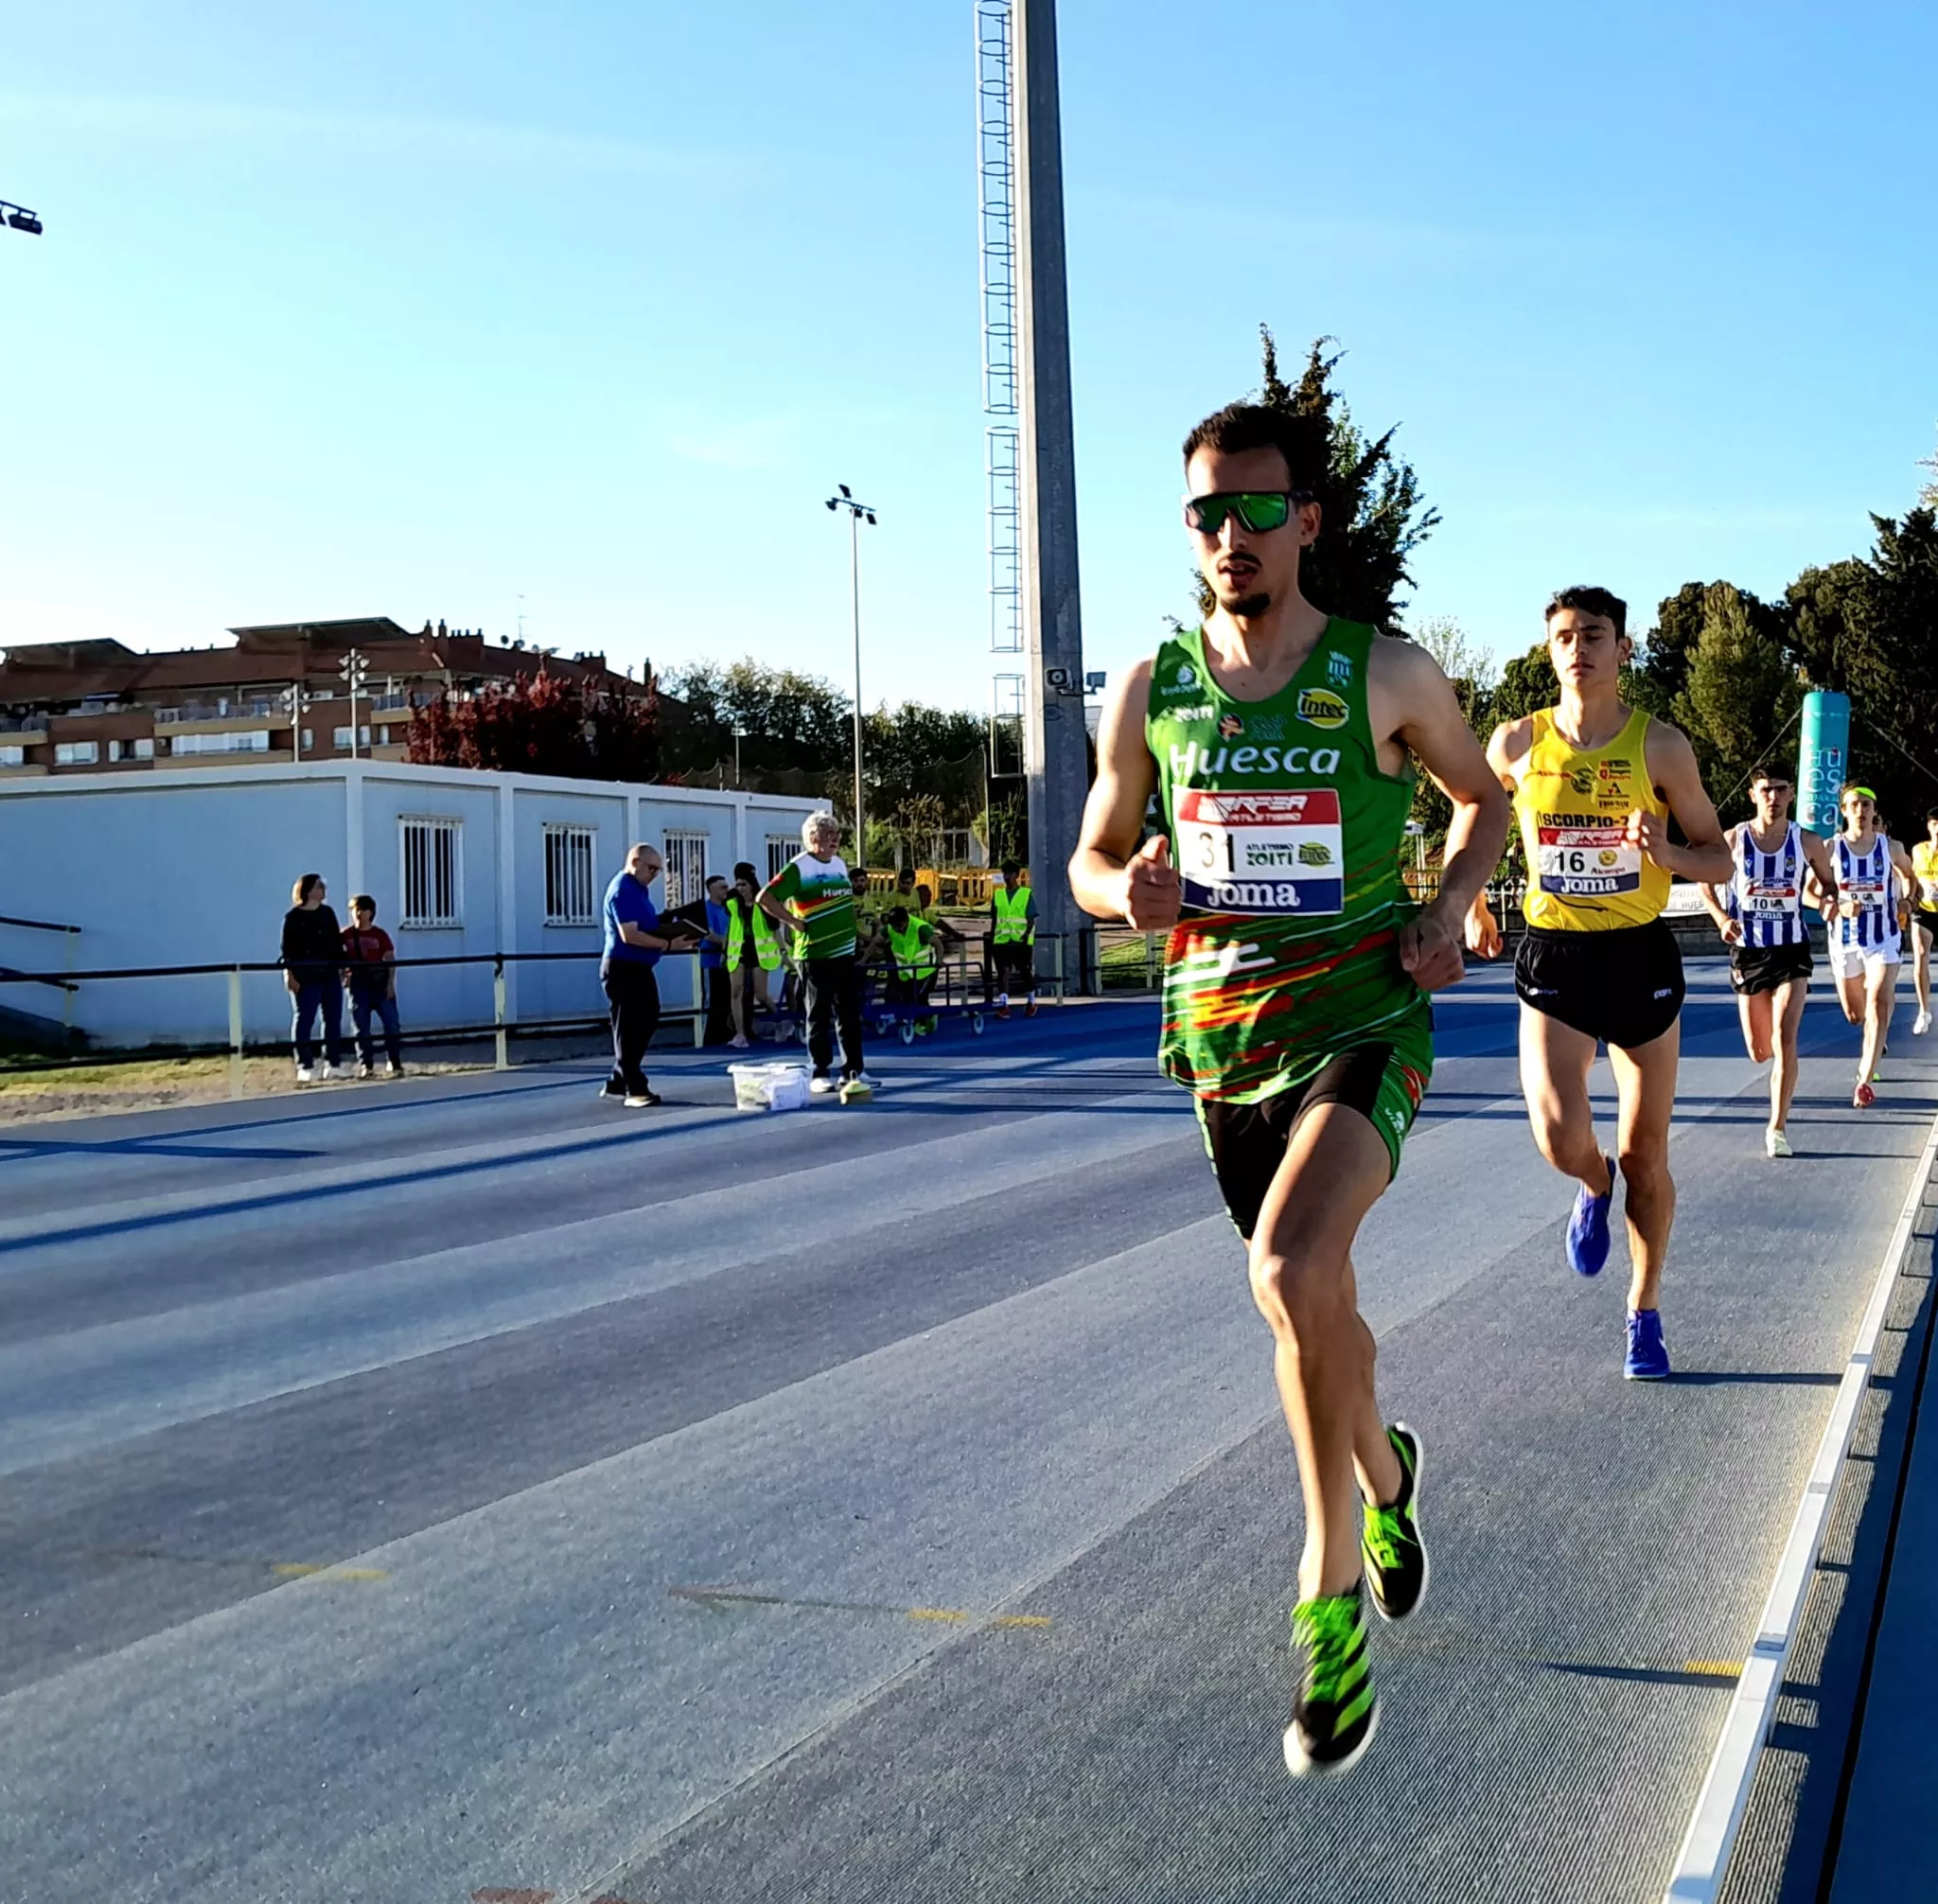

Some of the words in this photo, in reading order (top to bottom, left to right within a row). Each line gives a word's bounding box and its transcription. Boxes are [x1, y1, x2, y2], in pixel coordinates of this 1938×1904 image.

[1169, 741, 1341, 775] Huesca
[1198, 832, 1235, 873] 31
[1555, 851, 1585, 873] 16
[1752, 897, 1769, 909] 10
